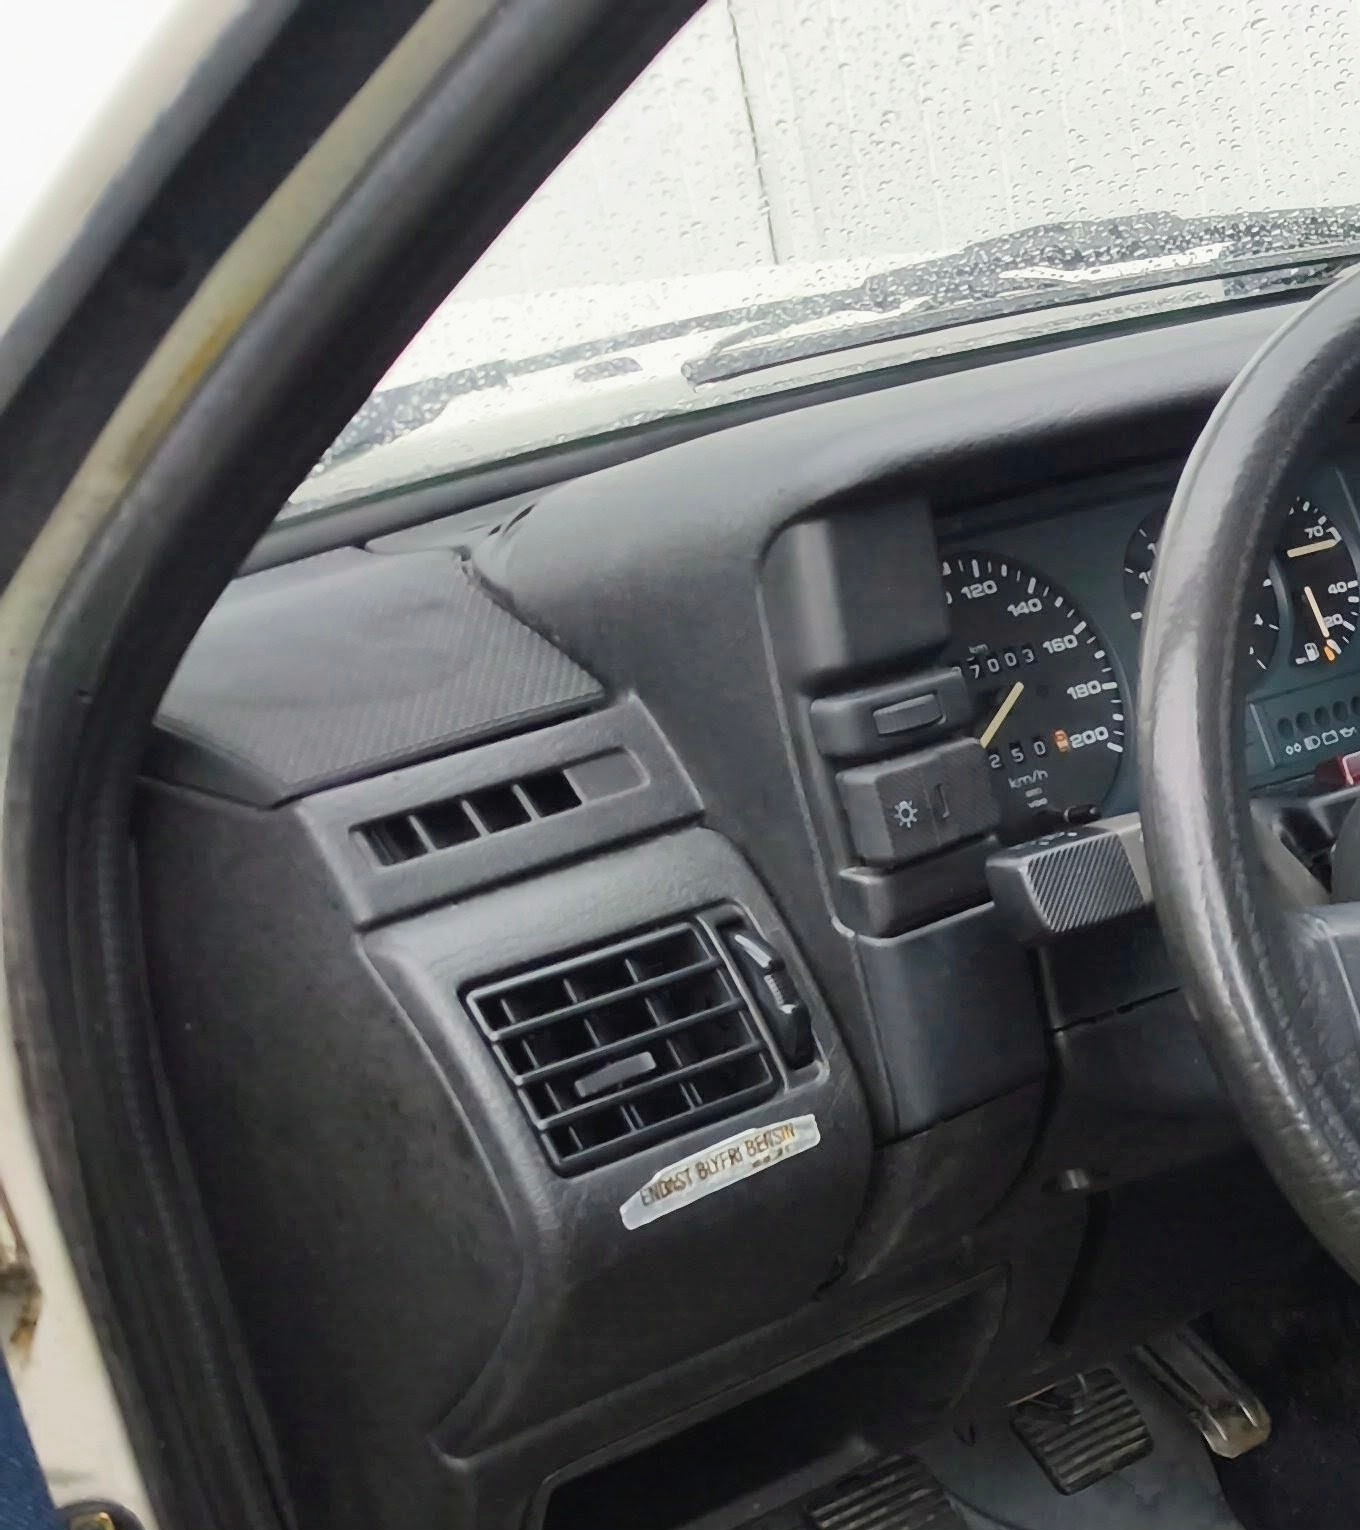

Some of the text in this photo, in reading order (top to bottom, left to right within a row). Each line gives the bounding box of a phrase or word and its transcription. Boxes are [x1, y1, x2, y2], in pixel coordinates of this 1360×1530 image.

[1304, 526, 1324, 539] 70
[960, 579, 998, 600] 120
[1327, 581, 1348, 594] 40
[1006, 597, 1043, 617] 140
[1323, 613, 1344, 628] 20
[968, 643, 989, 655] km
[1042, 633, 1078, 654] 160
[1066, 679, 1102, 700] 180
[1069, 726, 1109, 749] 200
[1008, 768, 1049, 790] km/h
